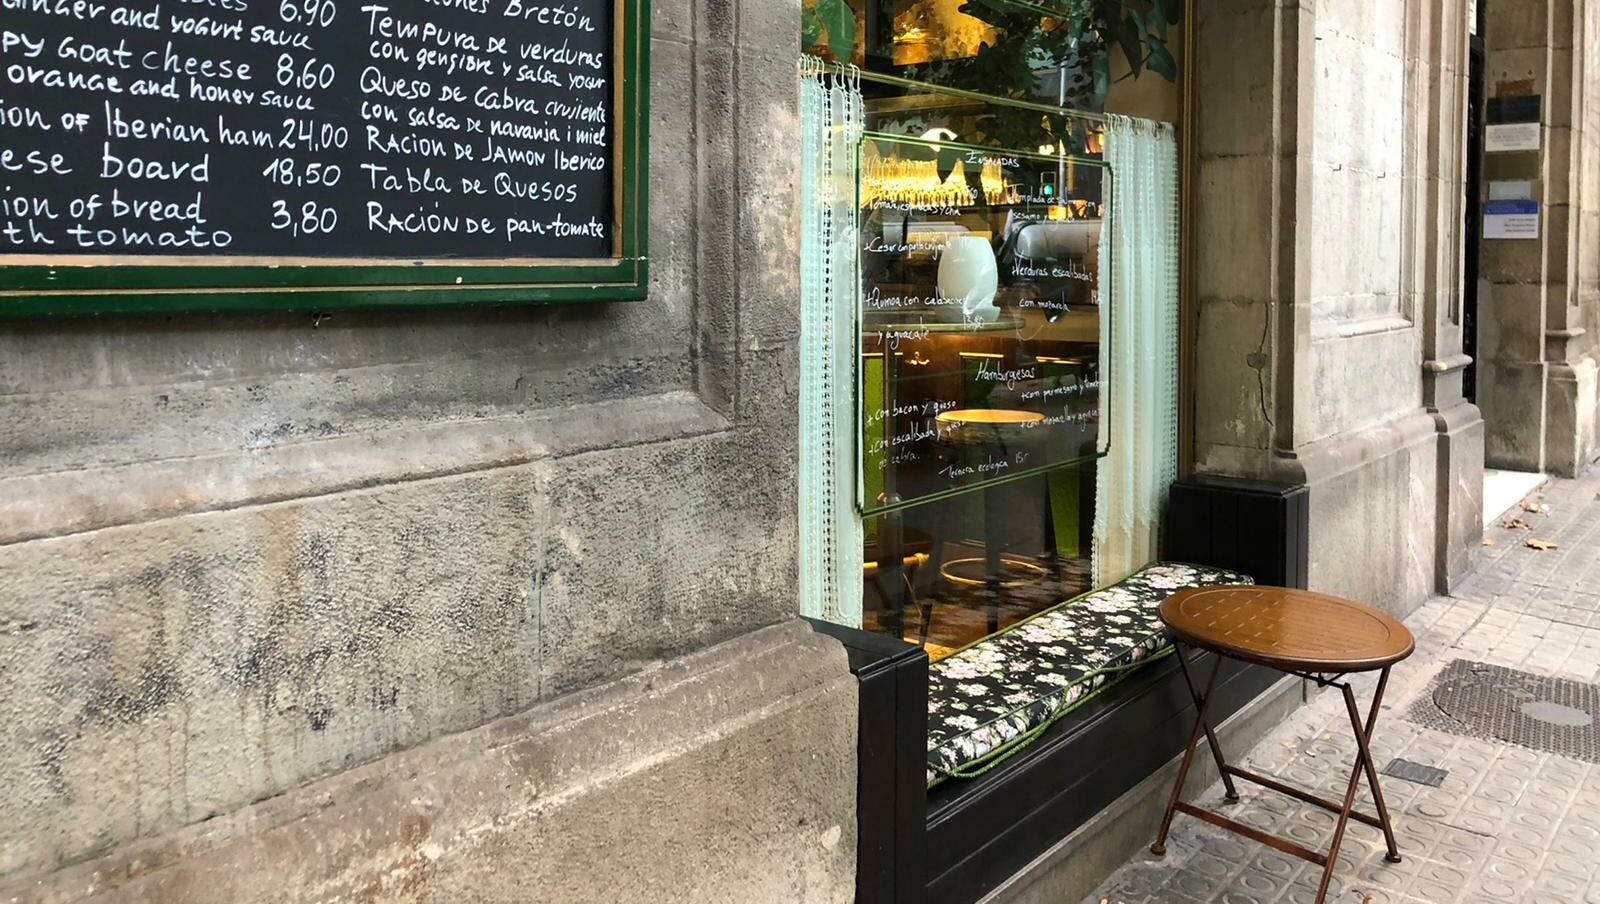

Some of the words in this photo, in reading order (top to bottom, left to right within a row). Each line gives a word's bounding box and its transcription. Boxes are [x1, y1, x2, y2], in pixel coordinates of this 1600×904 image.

[110, 4, 160, 30] and
[250, 26, 315, 50] sauce
[503, 0, 595, 32] Bretón
[142, 41, 252, 80] cheese
[369, 40, 410, 62] con
[502, 61, 511, 77] y
[516, 65, 562, 87] salsa
[520, 38, 603, 70] verduras
[129, 77, 180, 99] and
[190, 76, 255, 105] honey
[260, 91, 315, 110] sauce
[360, 66, 431, 100] Queso
[544, 98, 606, 124] crujiente
[105, 100, 210, 144] Iberian
[219, 114, 274, 149] ham
[361, 101, 398, 123] con
[408, 106, 461, 130] salsa
[490, 119, 561, 143] naranja
[575, 126, 606, 147] miel
[100, 141, 209, 182] board
[554, 149, 606, 171] Iberico
[360, 162, 452, 193] Tabla
[494, 171, 578, 202] Quesos
[69, 194, 103, 220] of
[112, 188, 207, 223] bread
[67, 224, 233, 247] tomato
[1019, 297, 1038, 308] con
[892, 400, 919, 416] bacon
